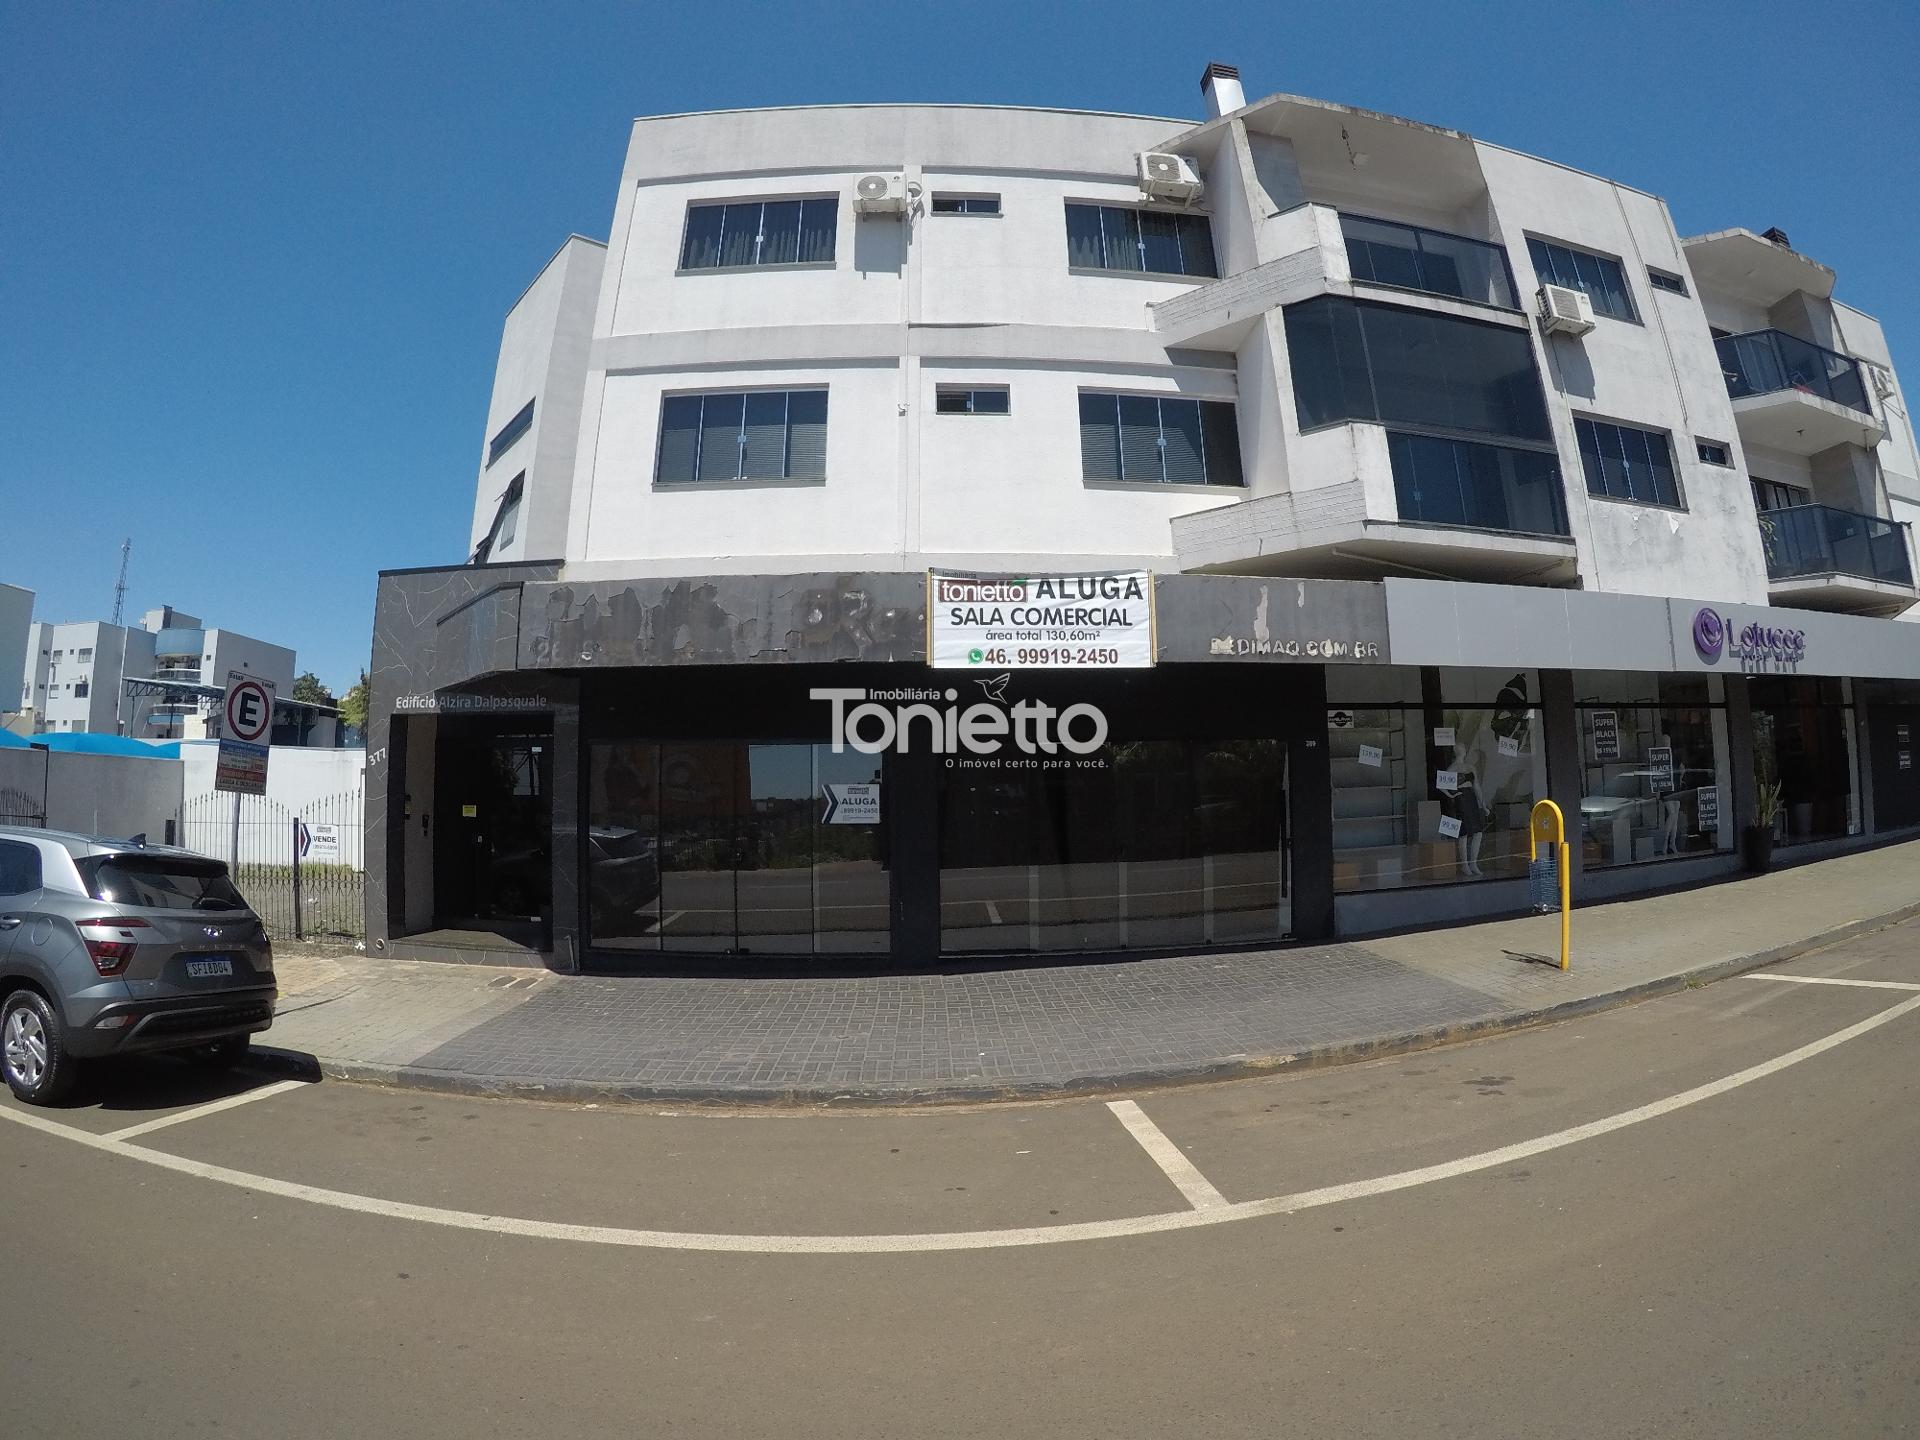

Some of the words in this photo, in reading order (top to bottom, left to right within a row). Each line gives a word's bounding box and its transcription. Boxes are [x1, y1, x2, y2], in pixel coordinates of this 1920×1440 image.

[942, 580, 1024, 602] tonietto
[1035, 576, 1144, 600] ALUGA
[950, 607, 1005, 626] SALA
[1010, 607, 1133, 627] COMERCIAL
[985, 630, 1012, 641] área
[1016, 630, 1042, 641] total
[1046, 630, 1100, 642] 130,60m²
[985, 649, 1012, 664] 46.
[1018, 648, 1119, 664] 99919-2450
[238, 691, 260, 727] E
[439, 696, 471, 708] Alzira
[474, 694, 547, 710] Dalpasquale
[1595, 718, 1615, 727] SUPER
[1596, 730, 1616, 738] BLACK
[368, 748, 386, 766] 377
[1651, 753, 1670, 761] SUPER
[313, 835, 337, 844] VENDE
